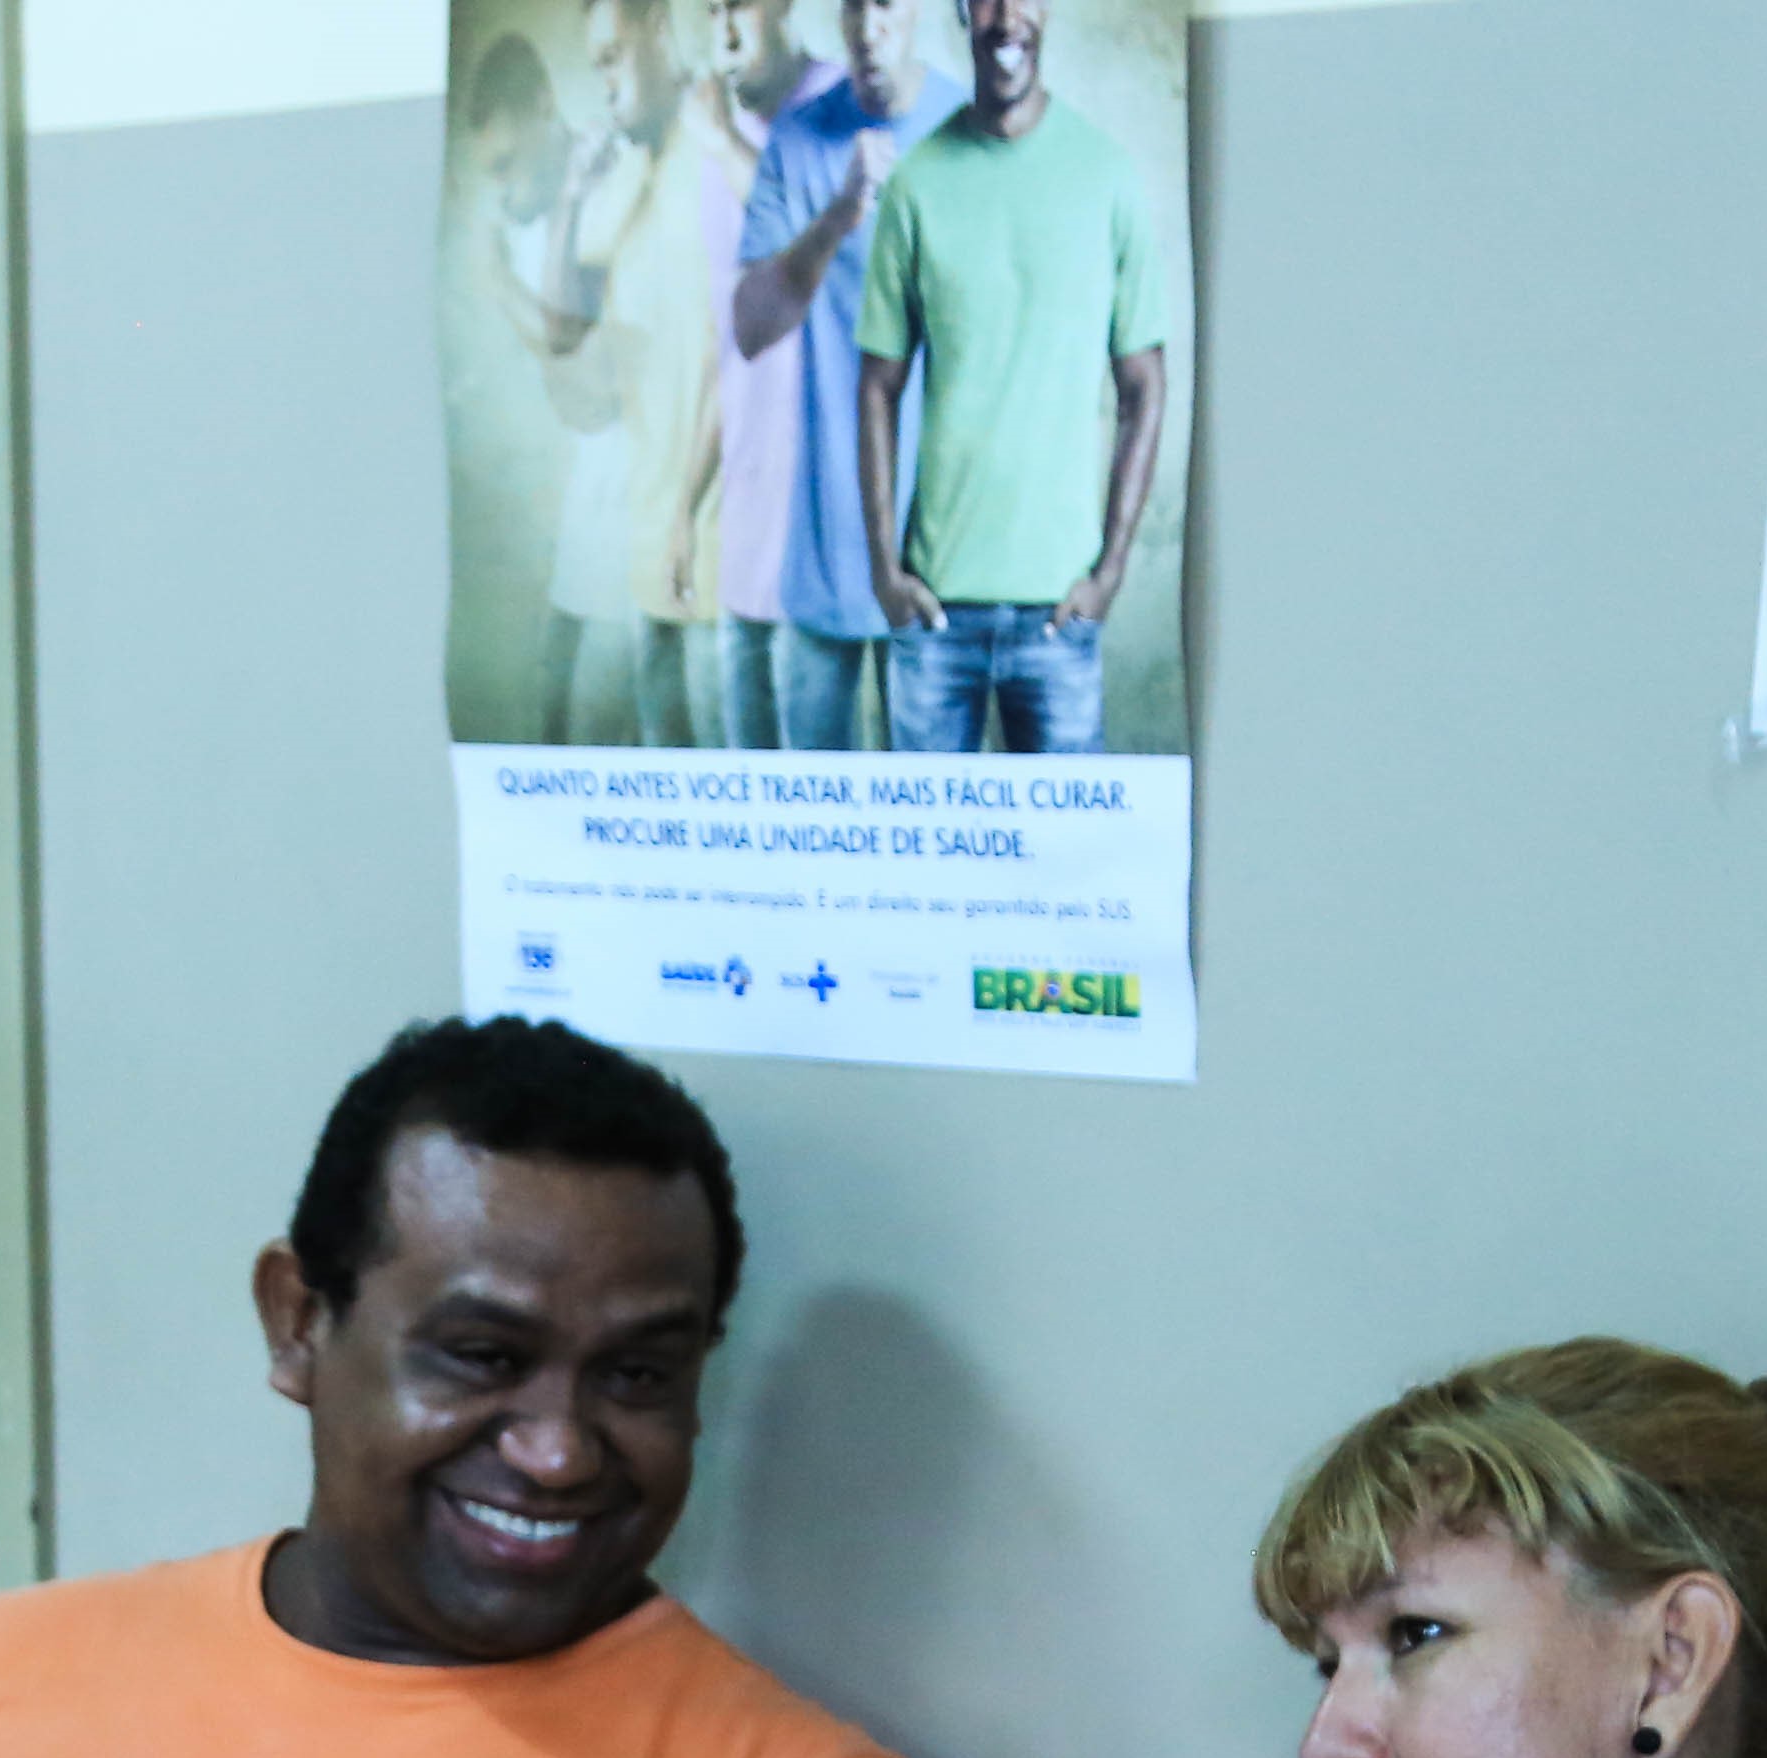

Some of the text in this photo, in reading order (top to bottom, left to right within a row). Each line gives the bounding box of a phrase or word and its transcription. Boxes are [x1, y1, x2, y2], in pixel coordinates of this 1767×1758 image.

[498, 767, 599, 797] QUANTO
[605, 771, 680, 799] ANTES
[686, 765, 752, 801] VOCÊ
[870, 776, 936, 805] MAIS
[944, 768, 1018, 808] FÁCIL
[1030, 778, 1132, 810] CURAR.
[583, 815, 690, 847] PROCURE
[698, 819, 753, 849] UMA
[759, 822, 881, 854] UNIDADE
[891, 826, 925, 855] DE
[973, 966, 1141, 1018] BRASIL
